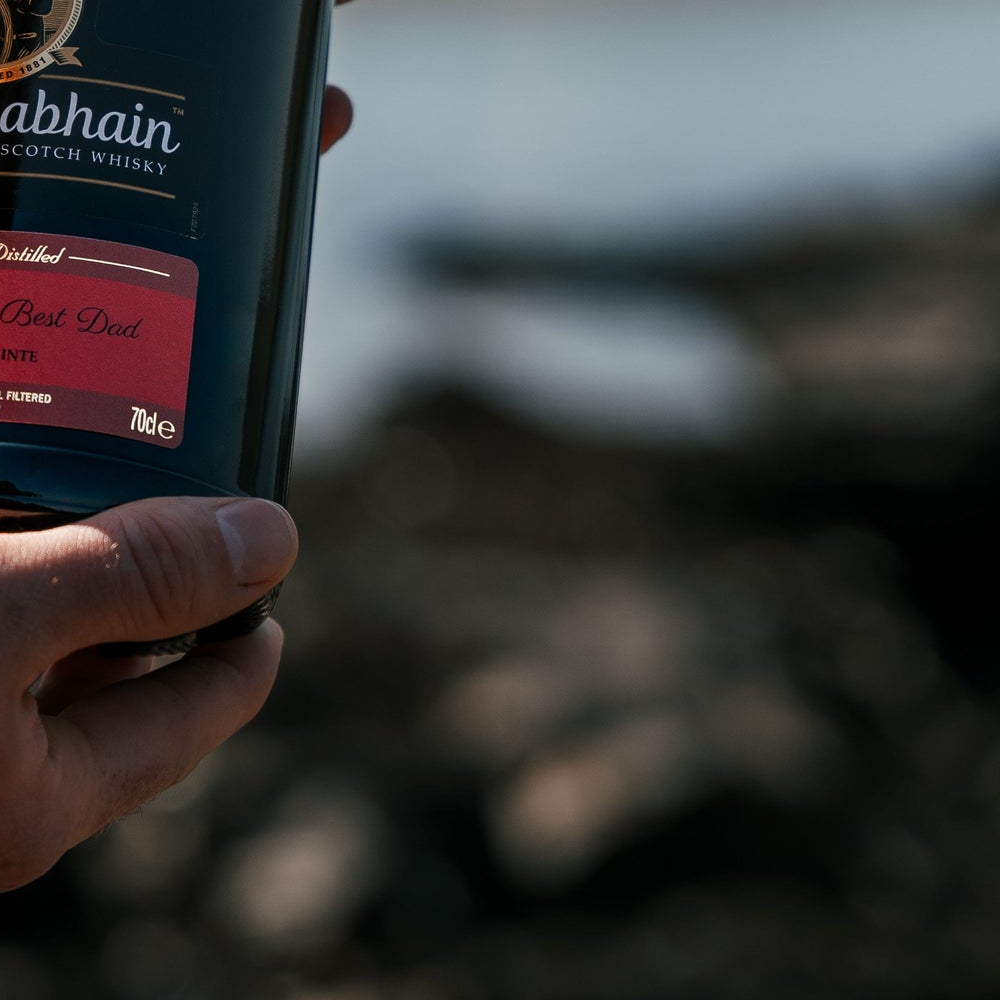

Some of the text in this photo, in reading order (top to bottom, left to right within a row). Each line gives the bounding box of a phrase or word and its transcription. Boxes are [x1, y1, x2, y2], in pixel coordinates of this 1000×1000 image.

[19, 56, 47, 74] 1881
[0, 143, 81, 161] SCOTCH
[91, 150, 167, 176] WHISKY
[0, 298, 69, 328] Best
[76, 306, 144, 339] Dad
[6, 390, 52, 404] FILTERED
